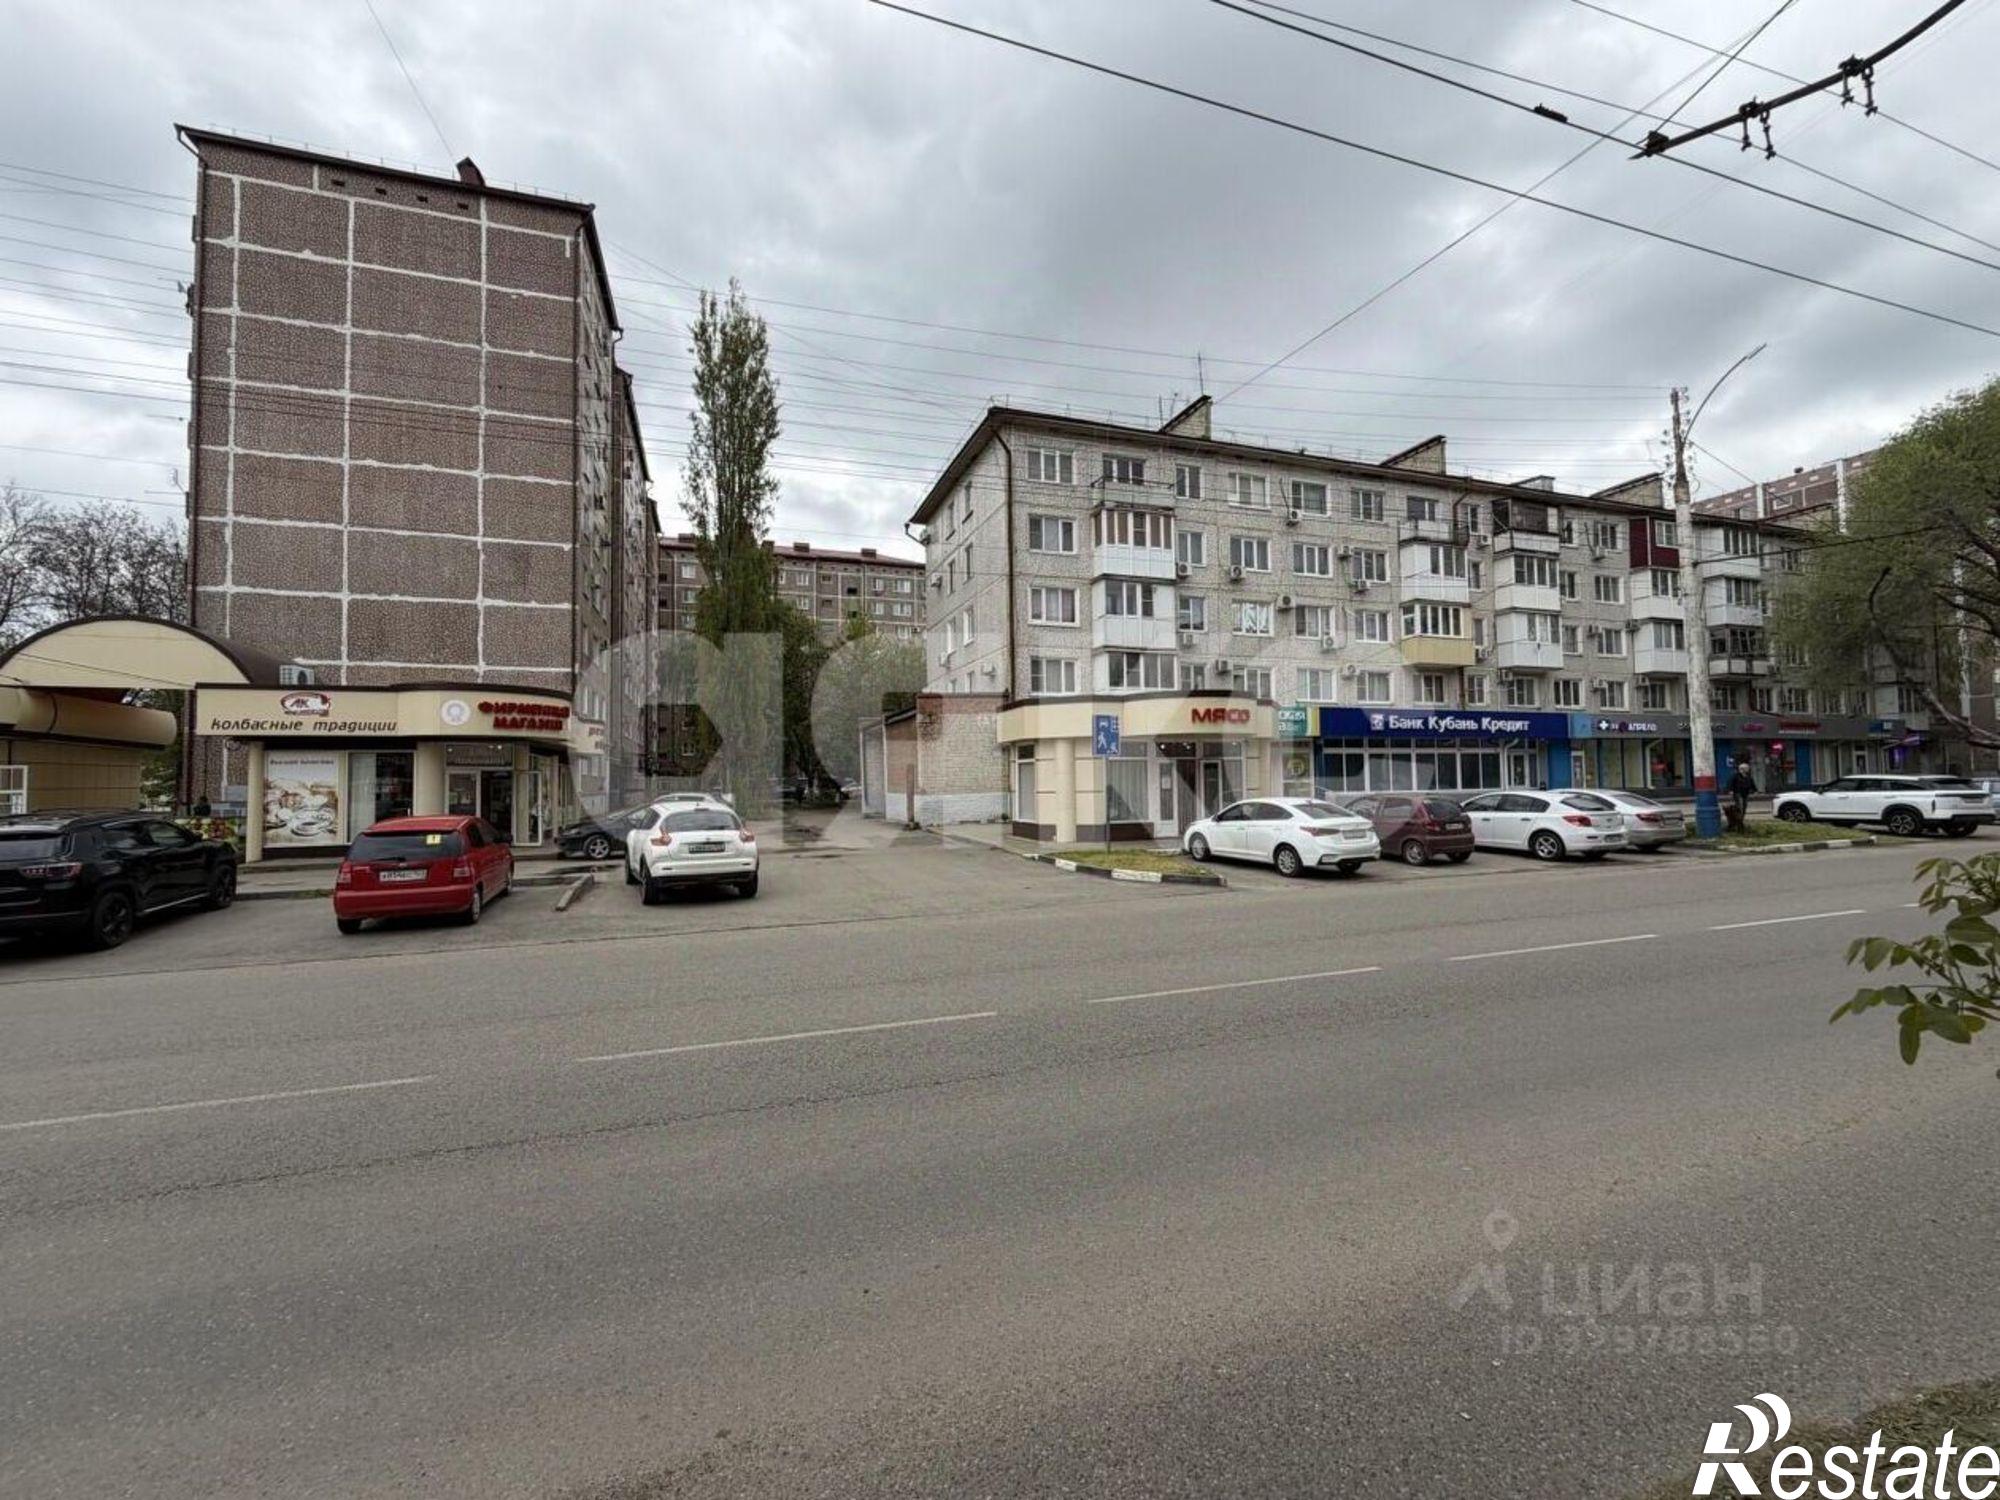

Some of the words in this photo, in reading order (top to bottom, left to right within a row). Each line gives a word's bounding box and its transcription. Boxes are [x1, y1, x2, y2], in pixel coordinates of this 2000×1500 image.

[312, 720, 397, 733] традиции
[1388, 715, 1425, 730] Банк
[1428, 715, 1479, 733] Кубань
[1481, 717, 1531, 733] Кредит
